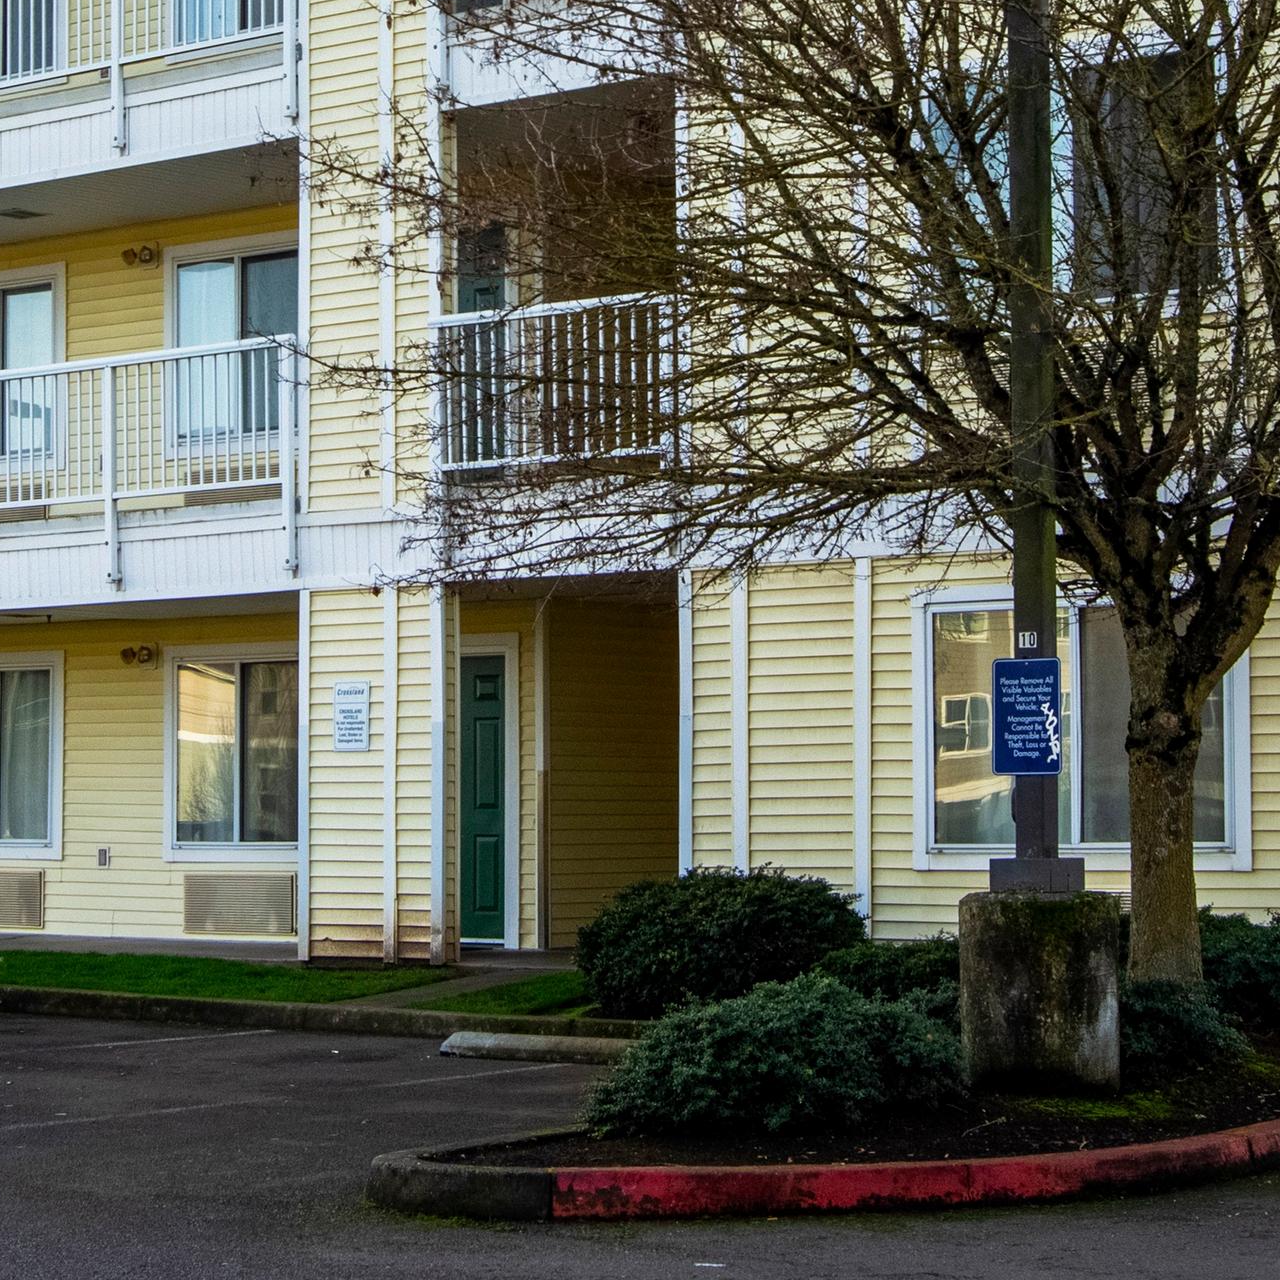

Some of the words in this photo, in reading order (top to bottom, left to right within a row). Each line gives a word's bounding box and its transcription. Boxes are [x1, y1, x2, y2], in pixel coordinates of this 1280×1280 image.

[1021, 632, 1036, 647] 10
[1000, 677, 1019, 685] Please
[1045, 675, 1054, 683] All
[1023, 685, 1051, 693] Valuables
[1002, 694, 1015, 702] and
[1007, 716, 1047, 724] Management
[1011, 723, 1033, 731] Cannot
[1005, 731, 1039, 741] Responsible
[1041, 731, 1050, 739] for
[1008, 740, 1024, 749] Theft,
[1013, 749, 1040, 758] Damage.
